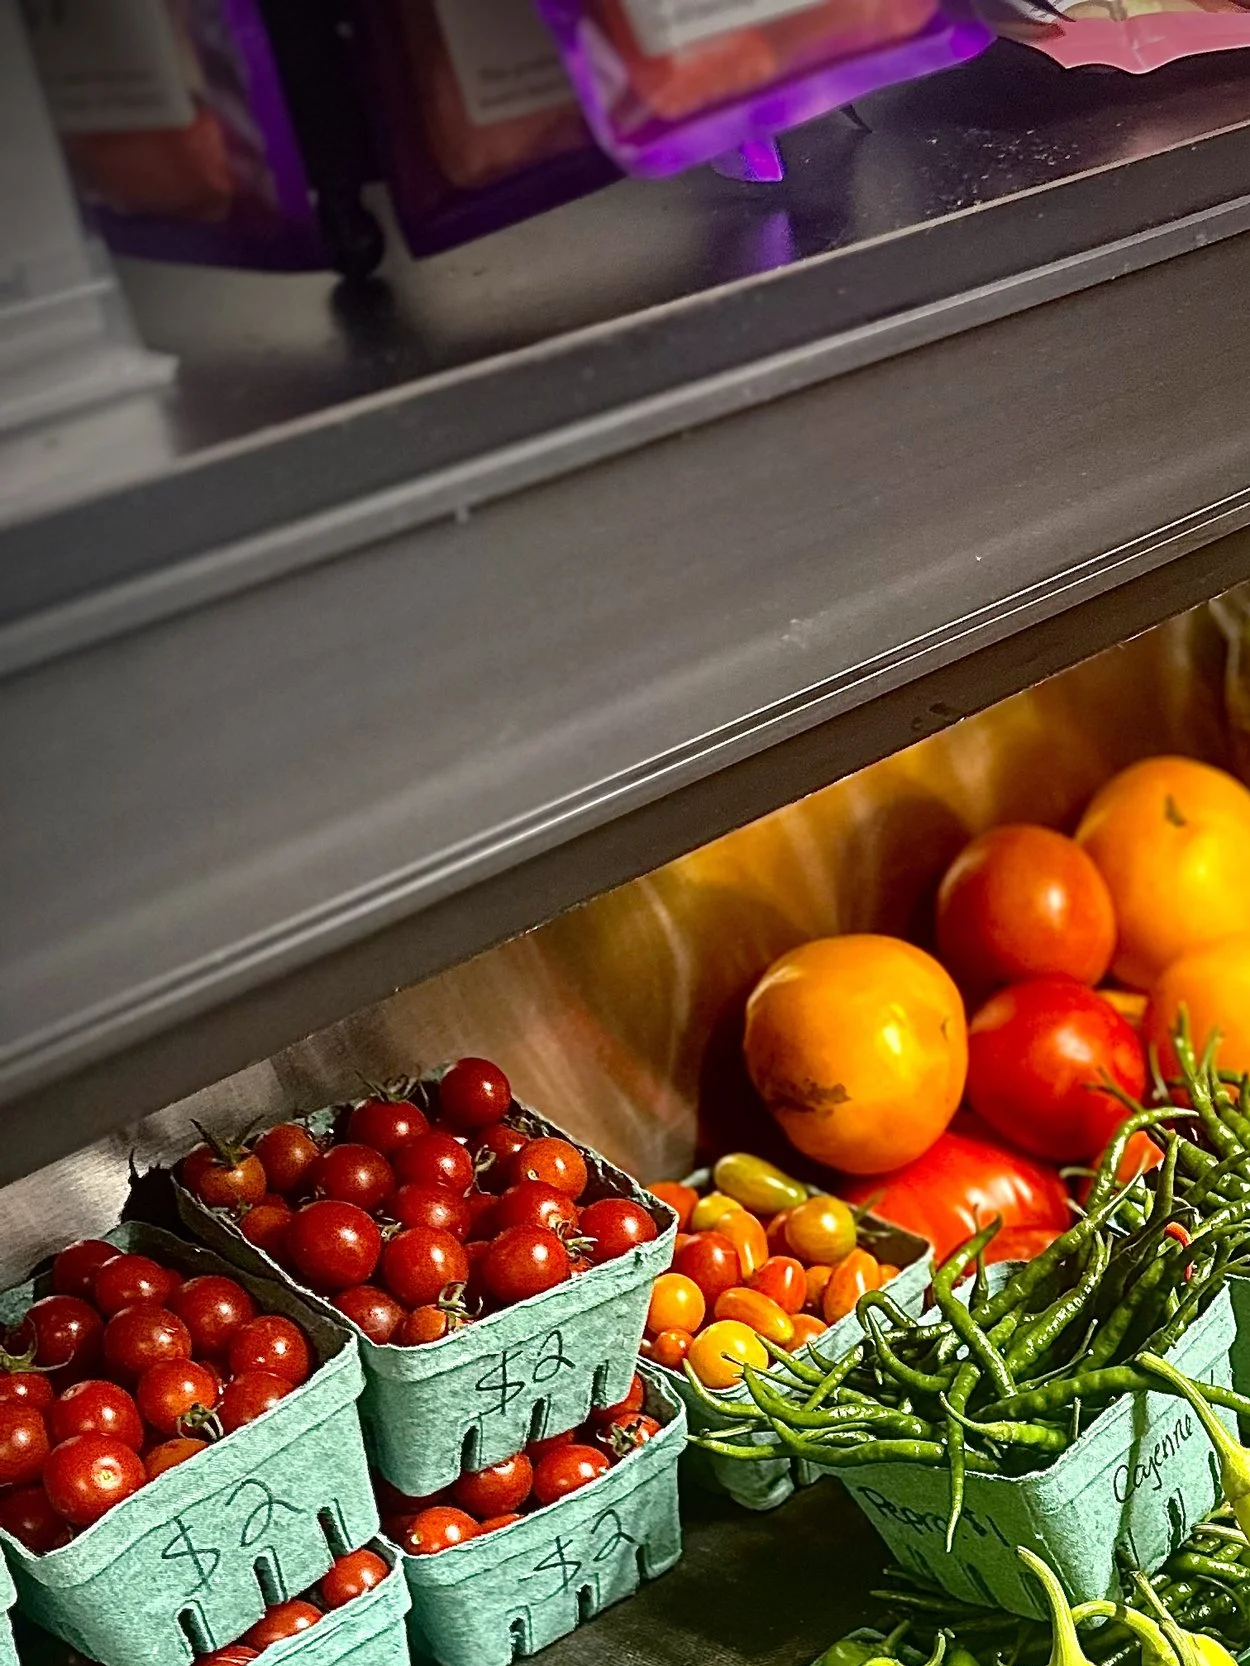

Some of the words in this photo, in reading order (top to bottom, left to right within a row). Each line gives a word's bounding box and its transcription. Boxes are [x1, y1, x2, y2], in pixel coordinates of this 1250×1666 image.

[466, 1329, 577, 1418] $2
[1113, 1413, 1194, 1504] Cayenne
[161, 1478, 307, 1597] $2
[525, 1508, 637, 1606] $2
